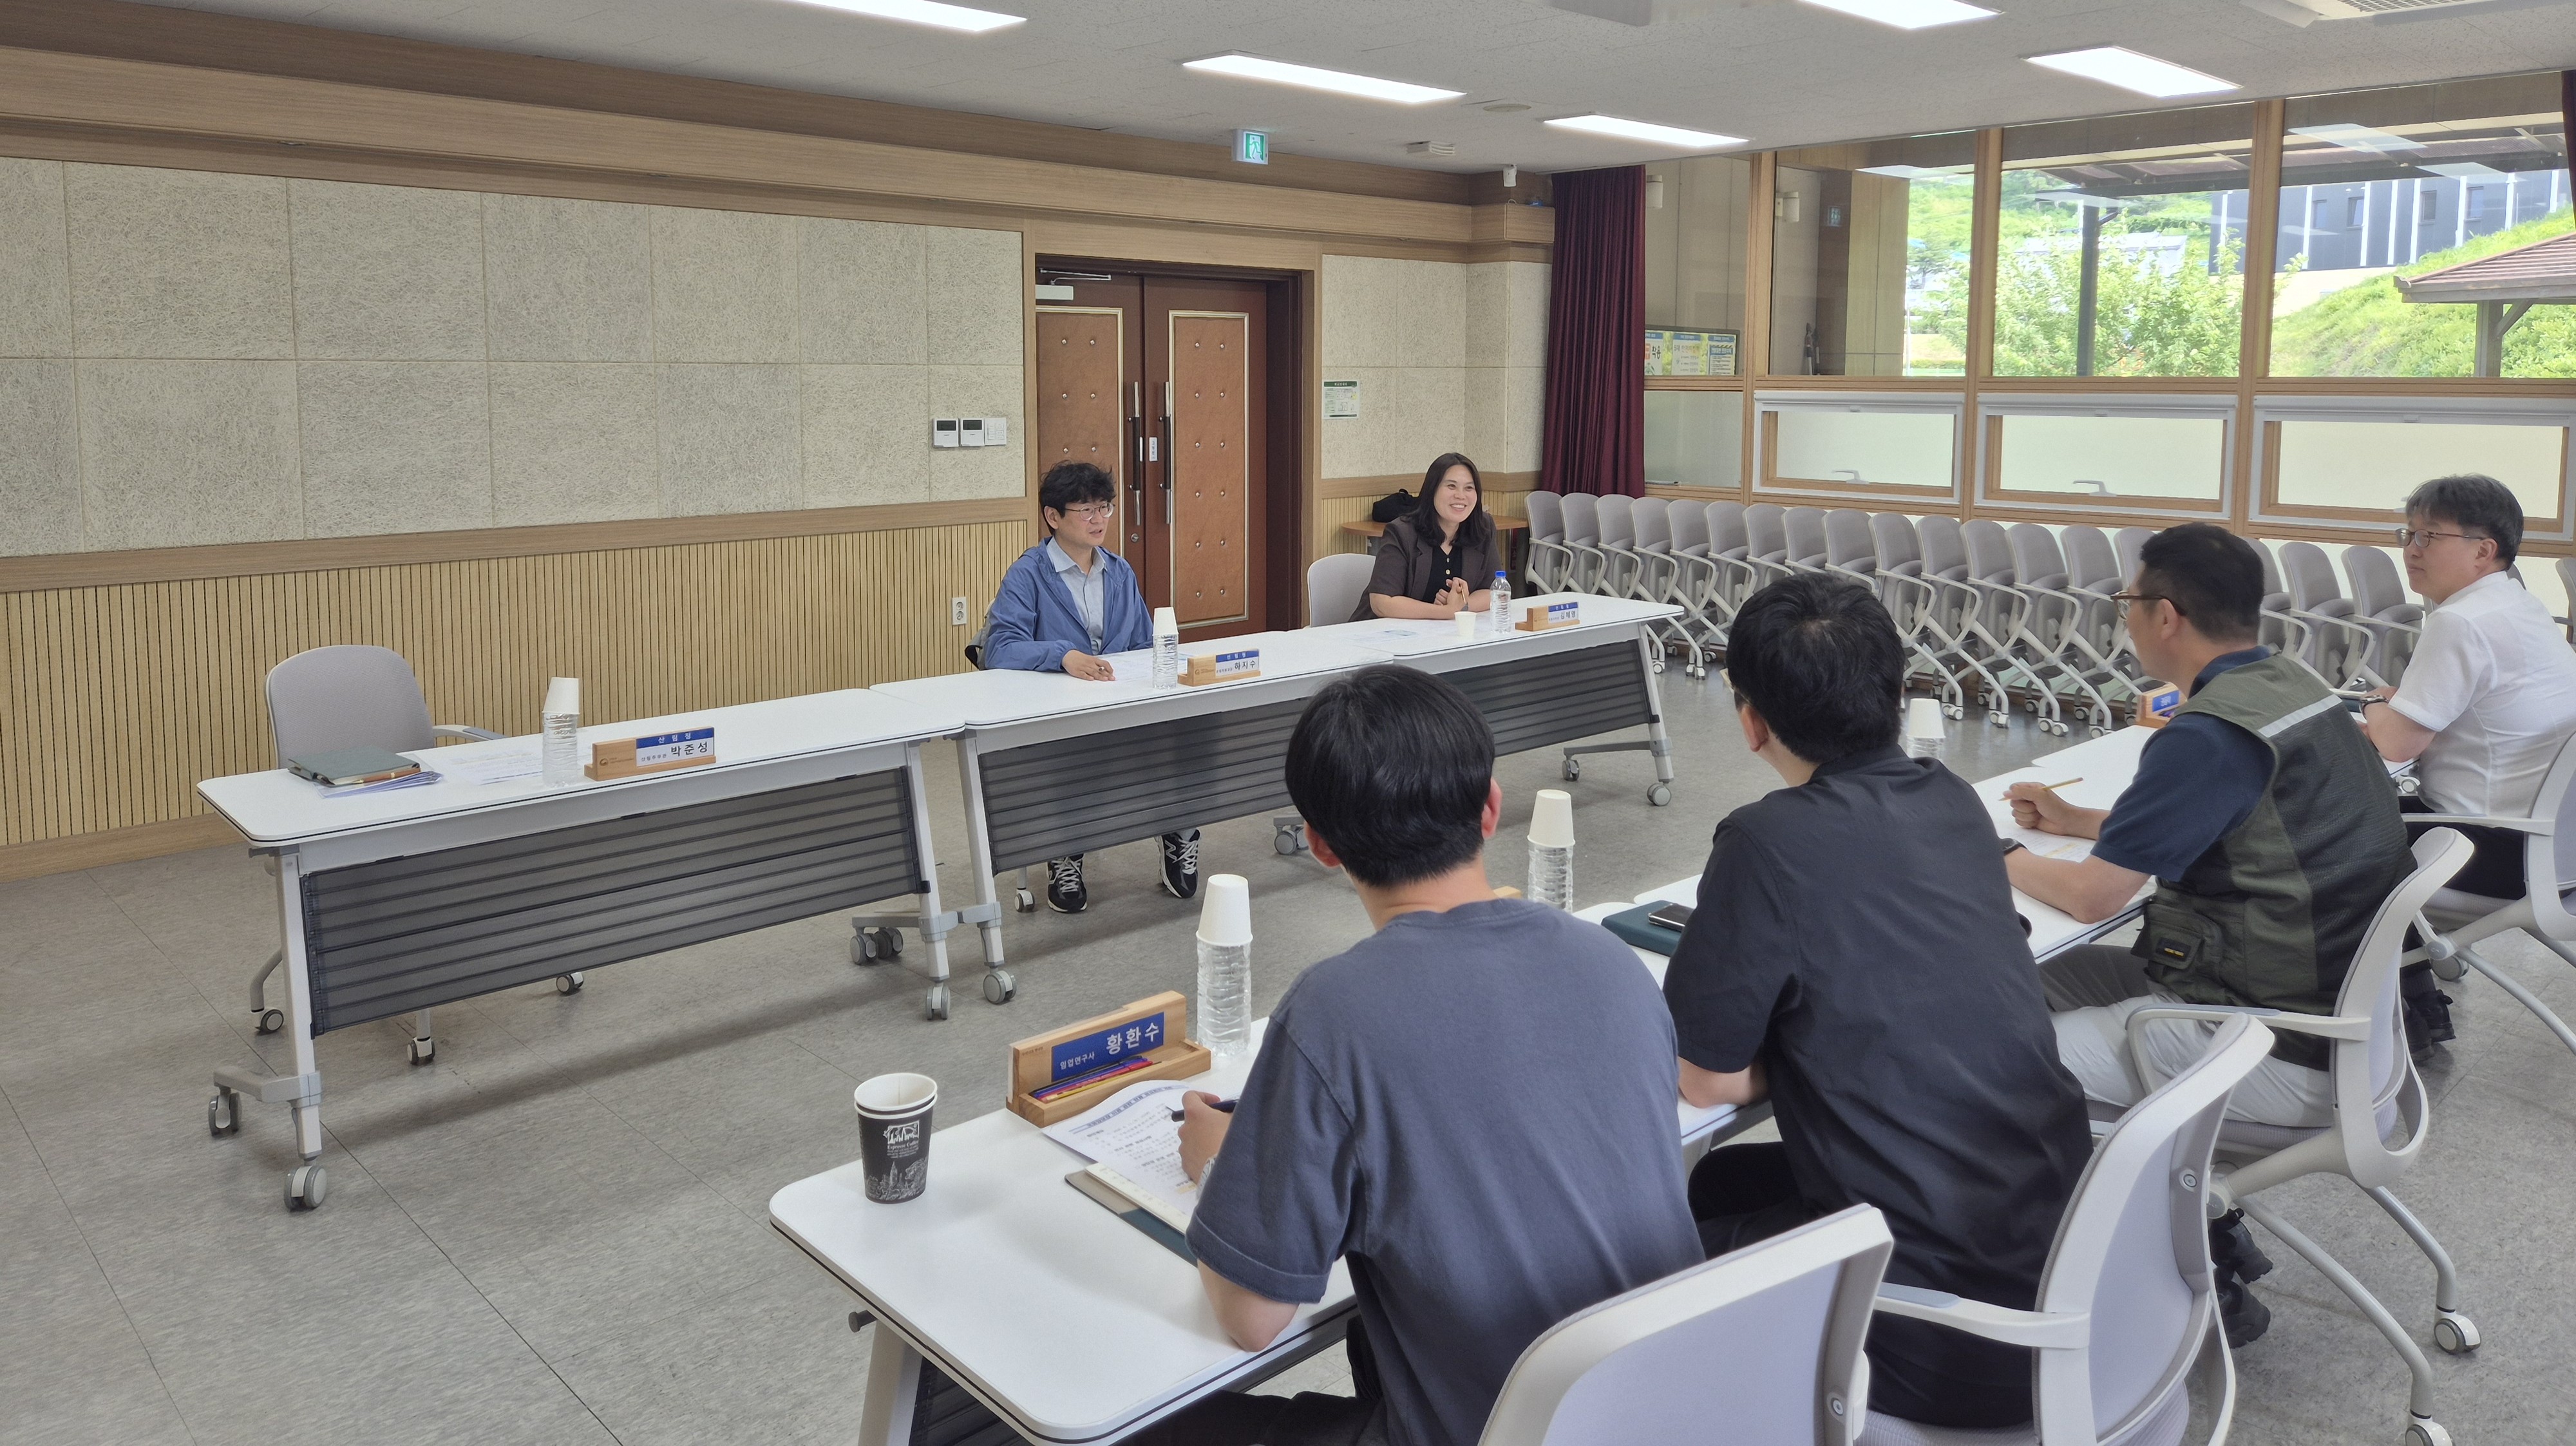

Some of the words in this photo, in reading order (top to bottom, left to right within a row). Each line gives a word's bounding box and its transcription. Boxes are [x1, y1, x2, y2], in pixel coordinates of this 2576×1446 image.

[1235, 660, 1255, 670] 하지수
[658, 732, 691, 744] 산림청
[671, 741, 708, 757] 박준성
[1059, 1051, 1095, 1070] 임업연구사
[1106, 1022, 1159, 1055] 황환수
